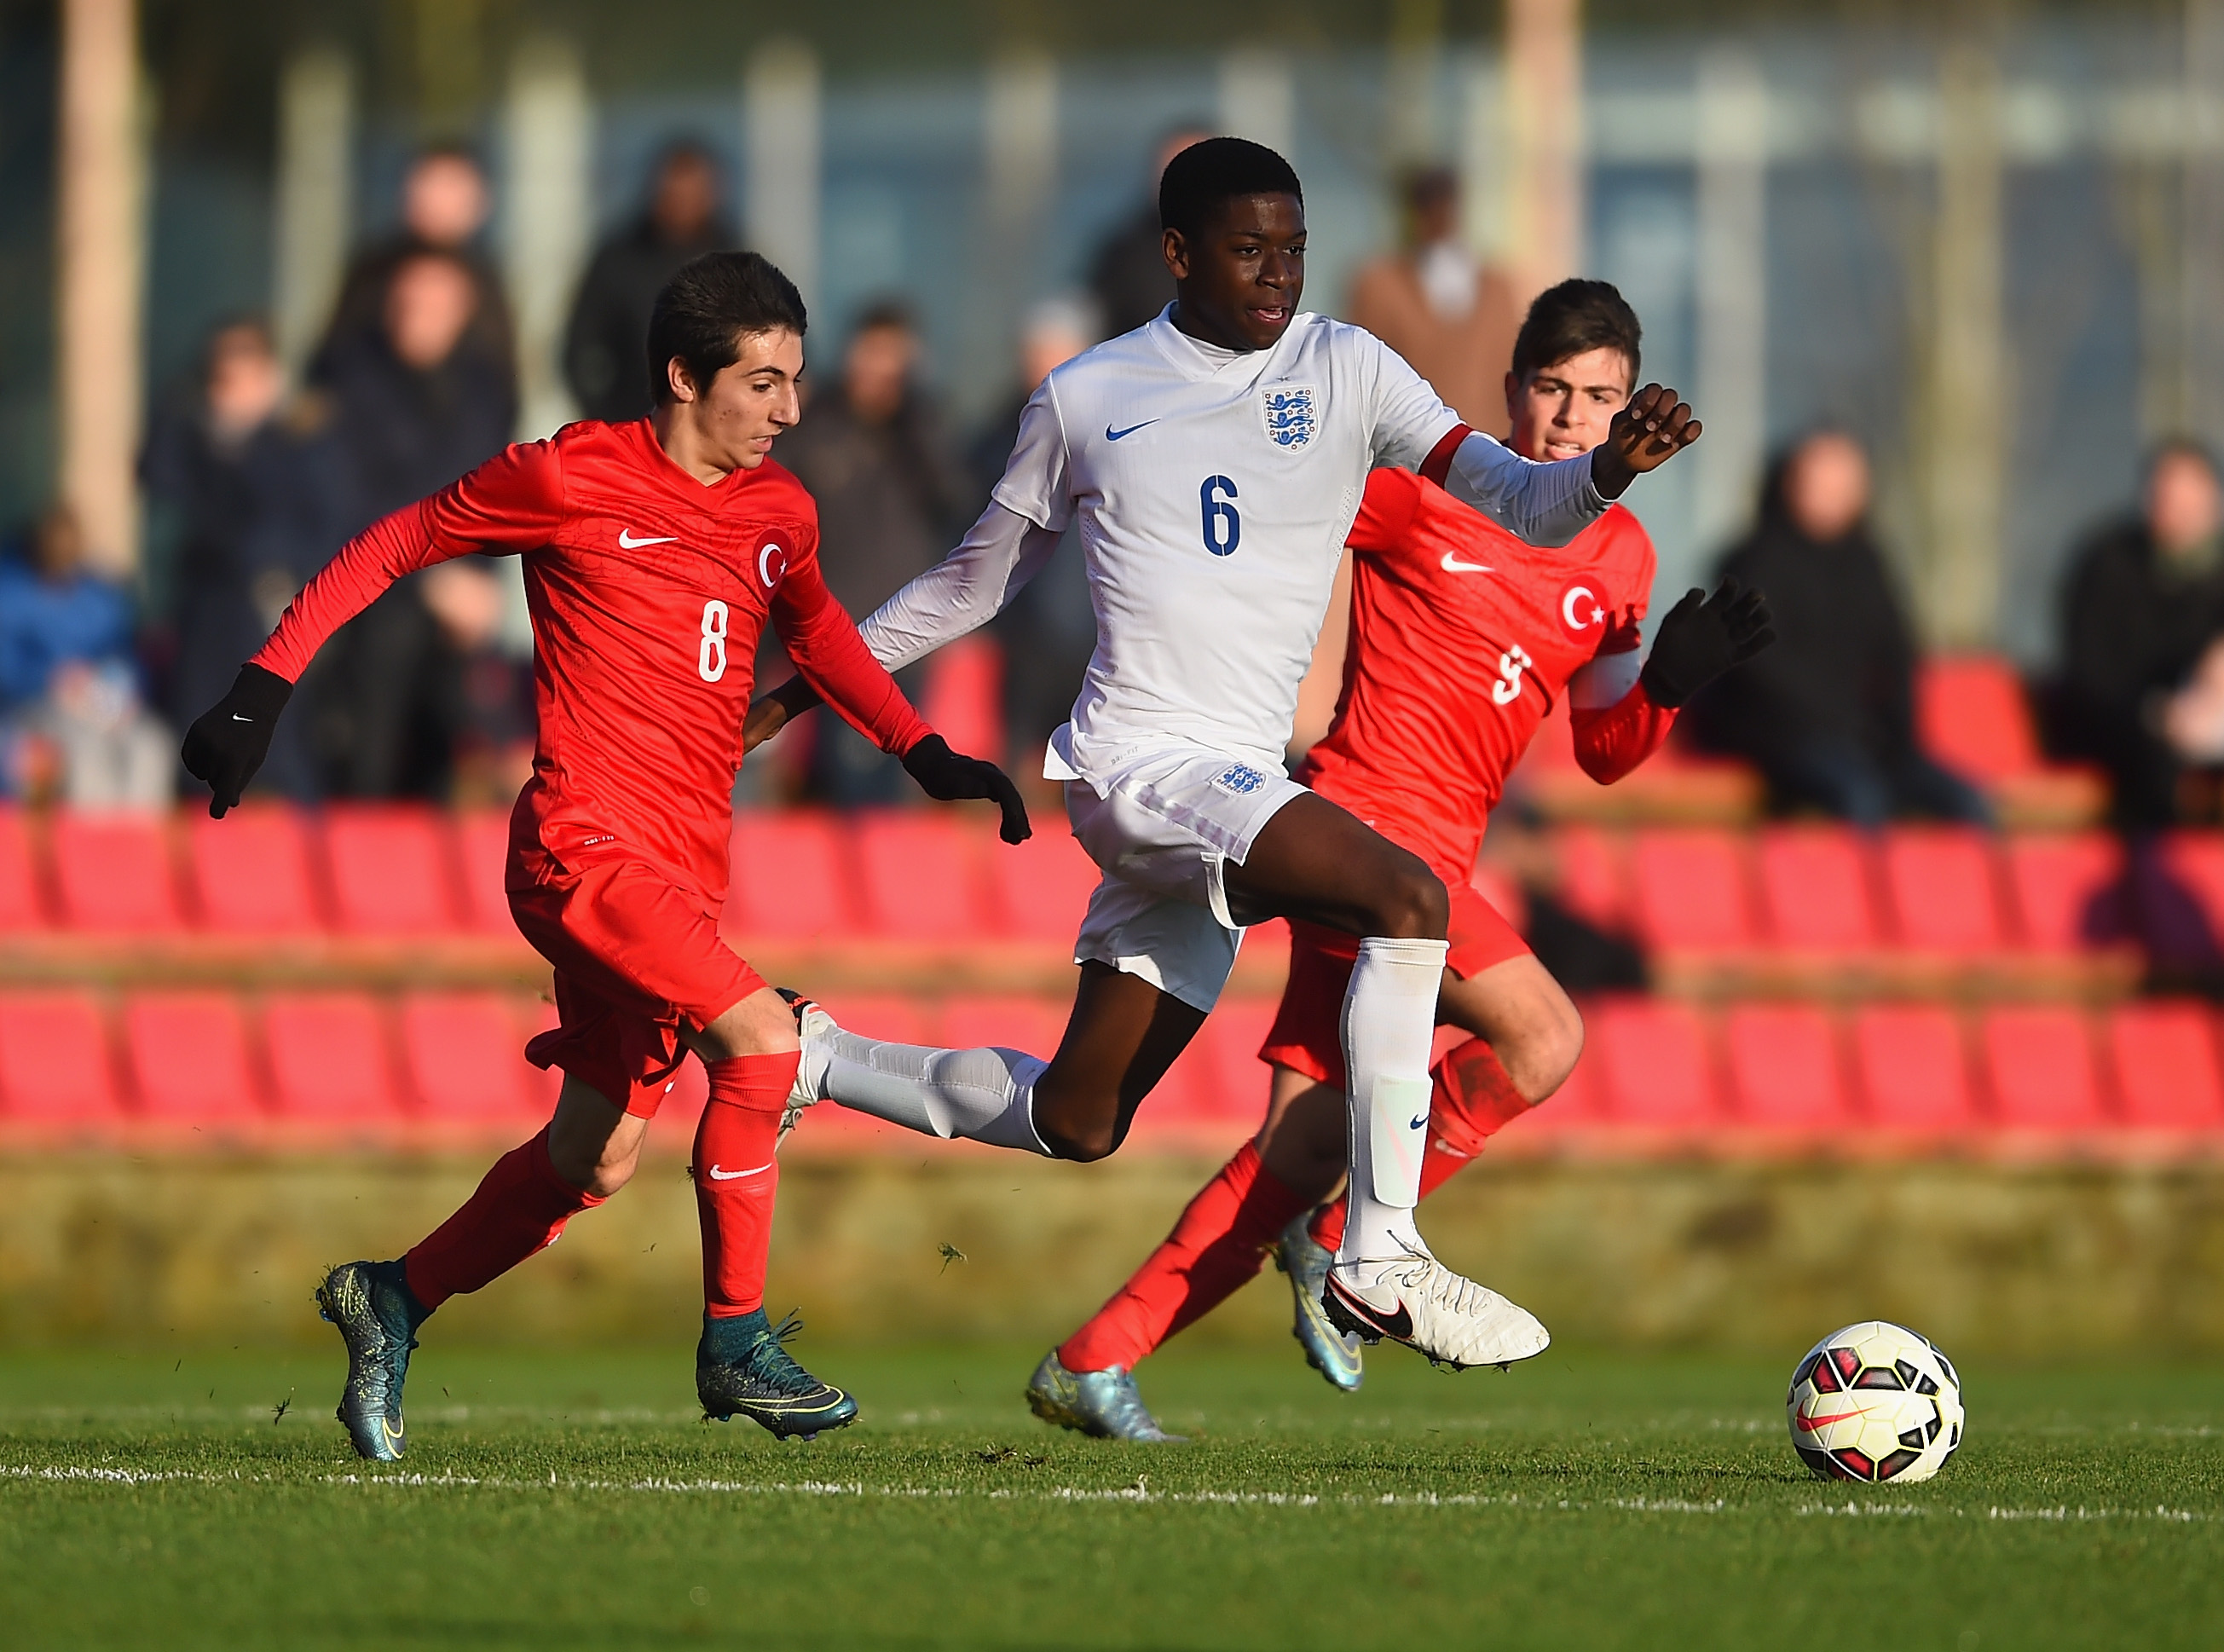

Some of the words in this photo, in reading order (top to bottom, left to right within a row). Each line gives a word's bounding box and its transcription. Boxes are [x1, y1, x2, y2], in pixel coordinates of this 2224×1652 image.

[1199, 473, 1241, 557] 6
[698, 599, 730, 683] 8
[1493, 644, 1533, 706] 9
